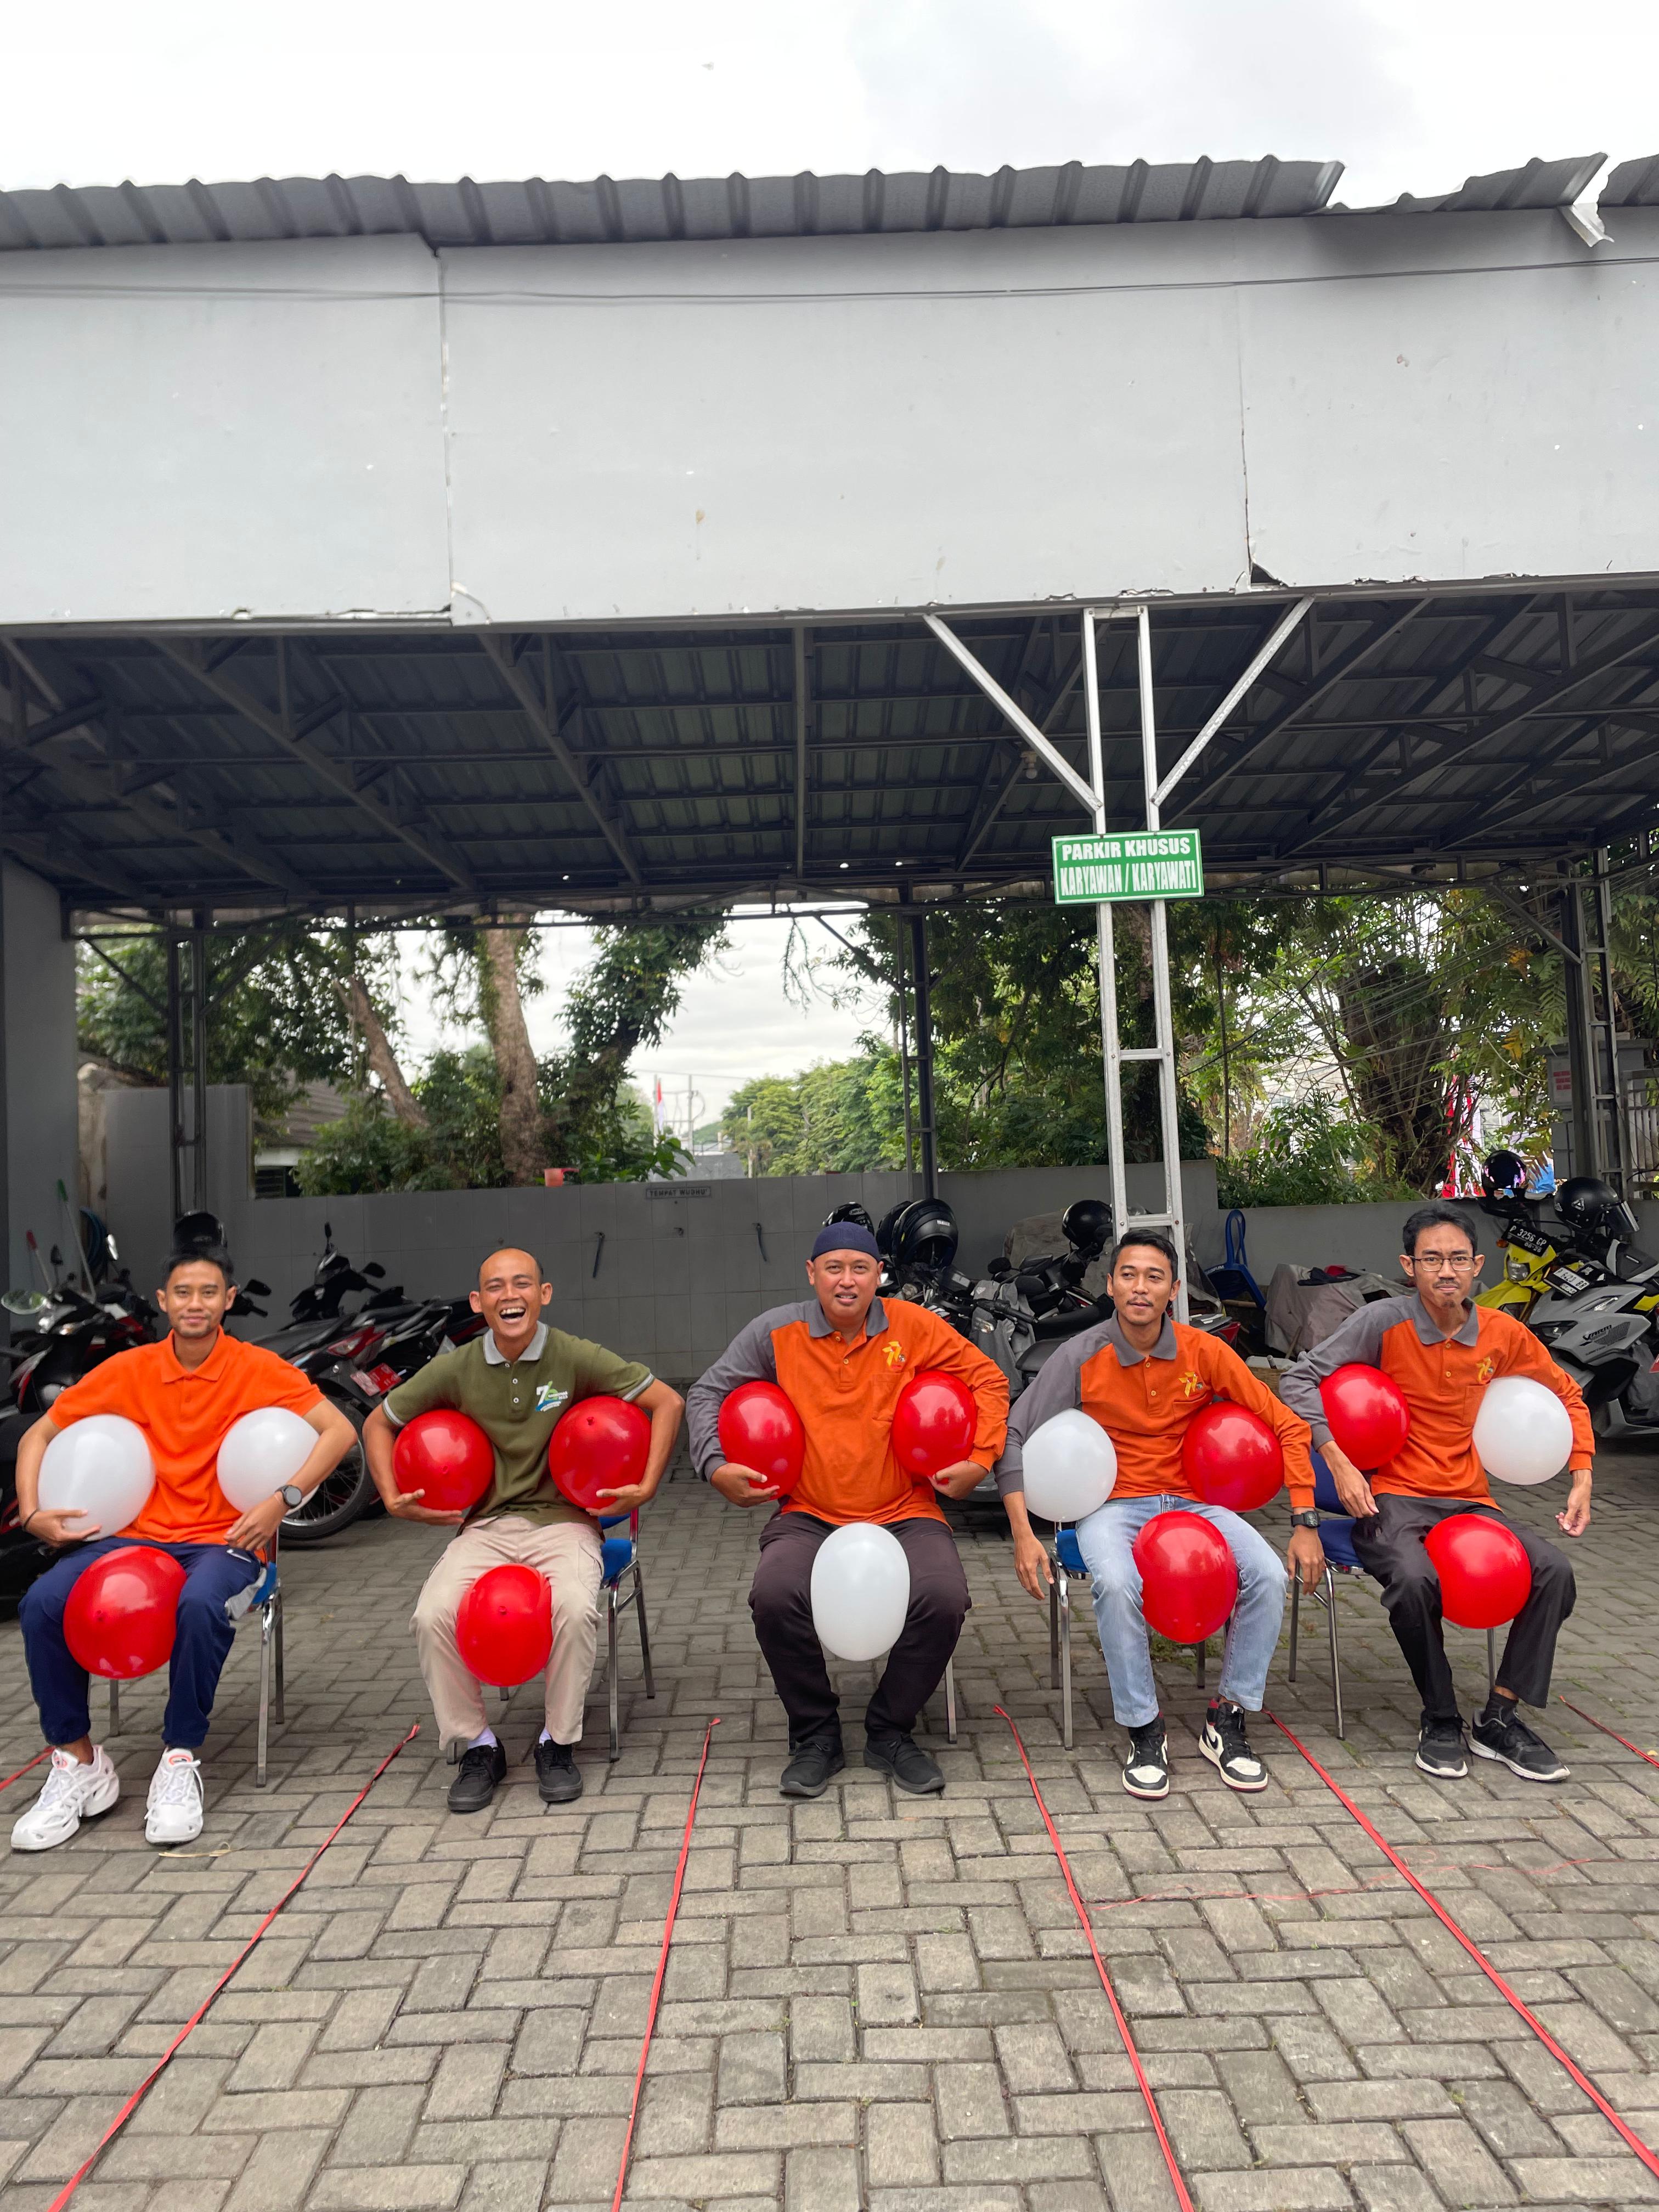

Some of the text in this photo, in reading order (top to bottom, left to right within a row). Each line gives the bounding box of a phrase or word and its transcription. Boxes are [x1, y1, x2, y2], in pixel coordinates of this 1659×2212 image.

[1062, 837, 1190, 861] PARKIR KHUSUS
[1060, 864, 1122, 896] KARYAWAN
[1131, 860, 1197, 891] KARYAWATI
[1517, 1229, 1536, 1242] 3256
